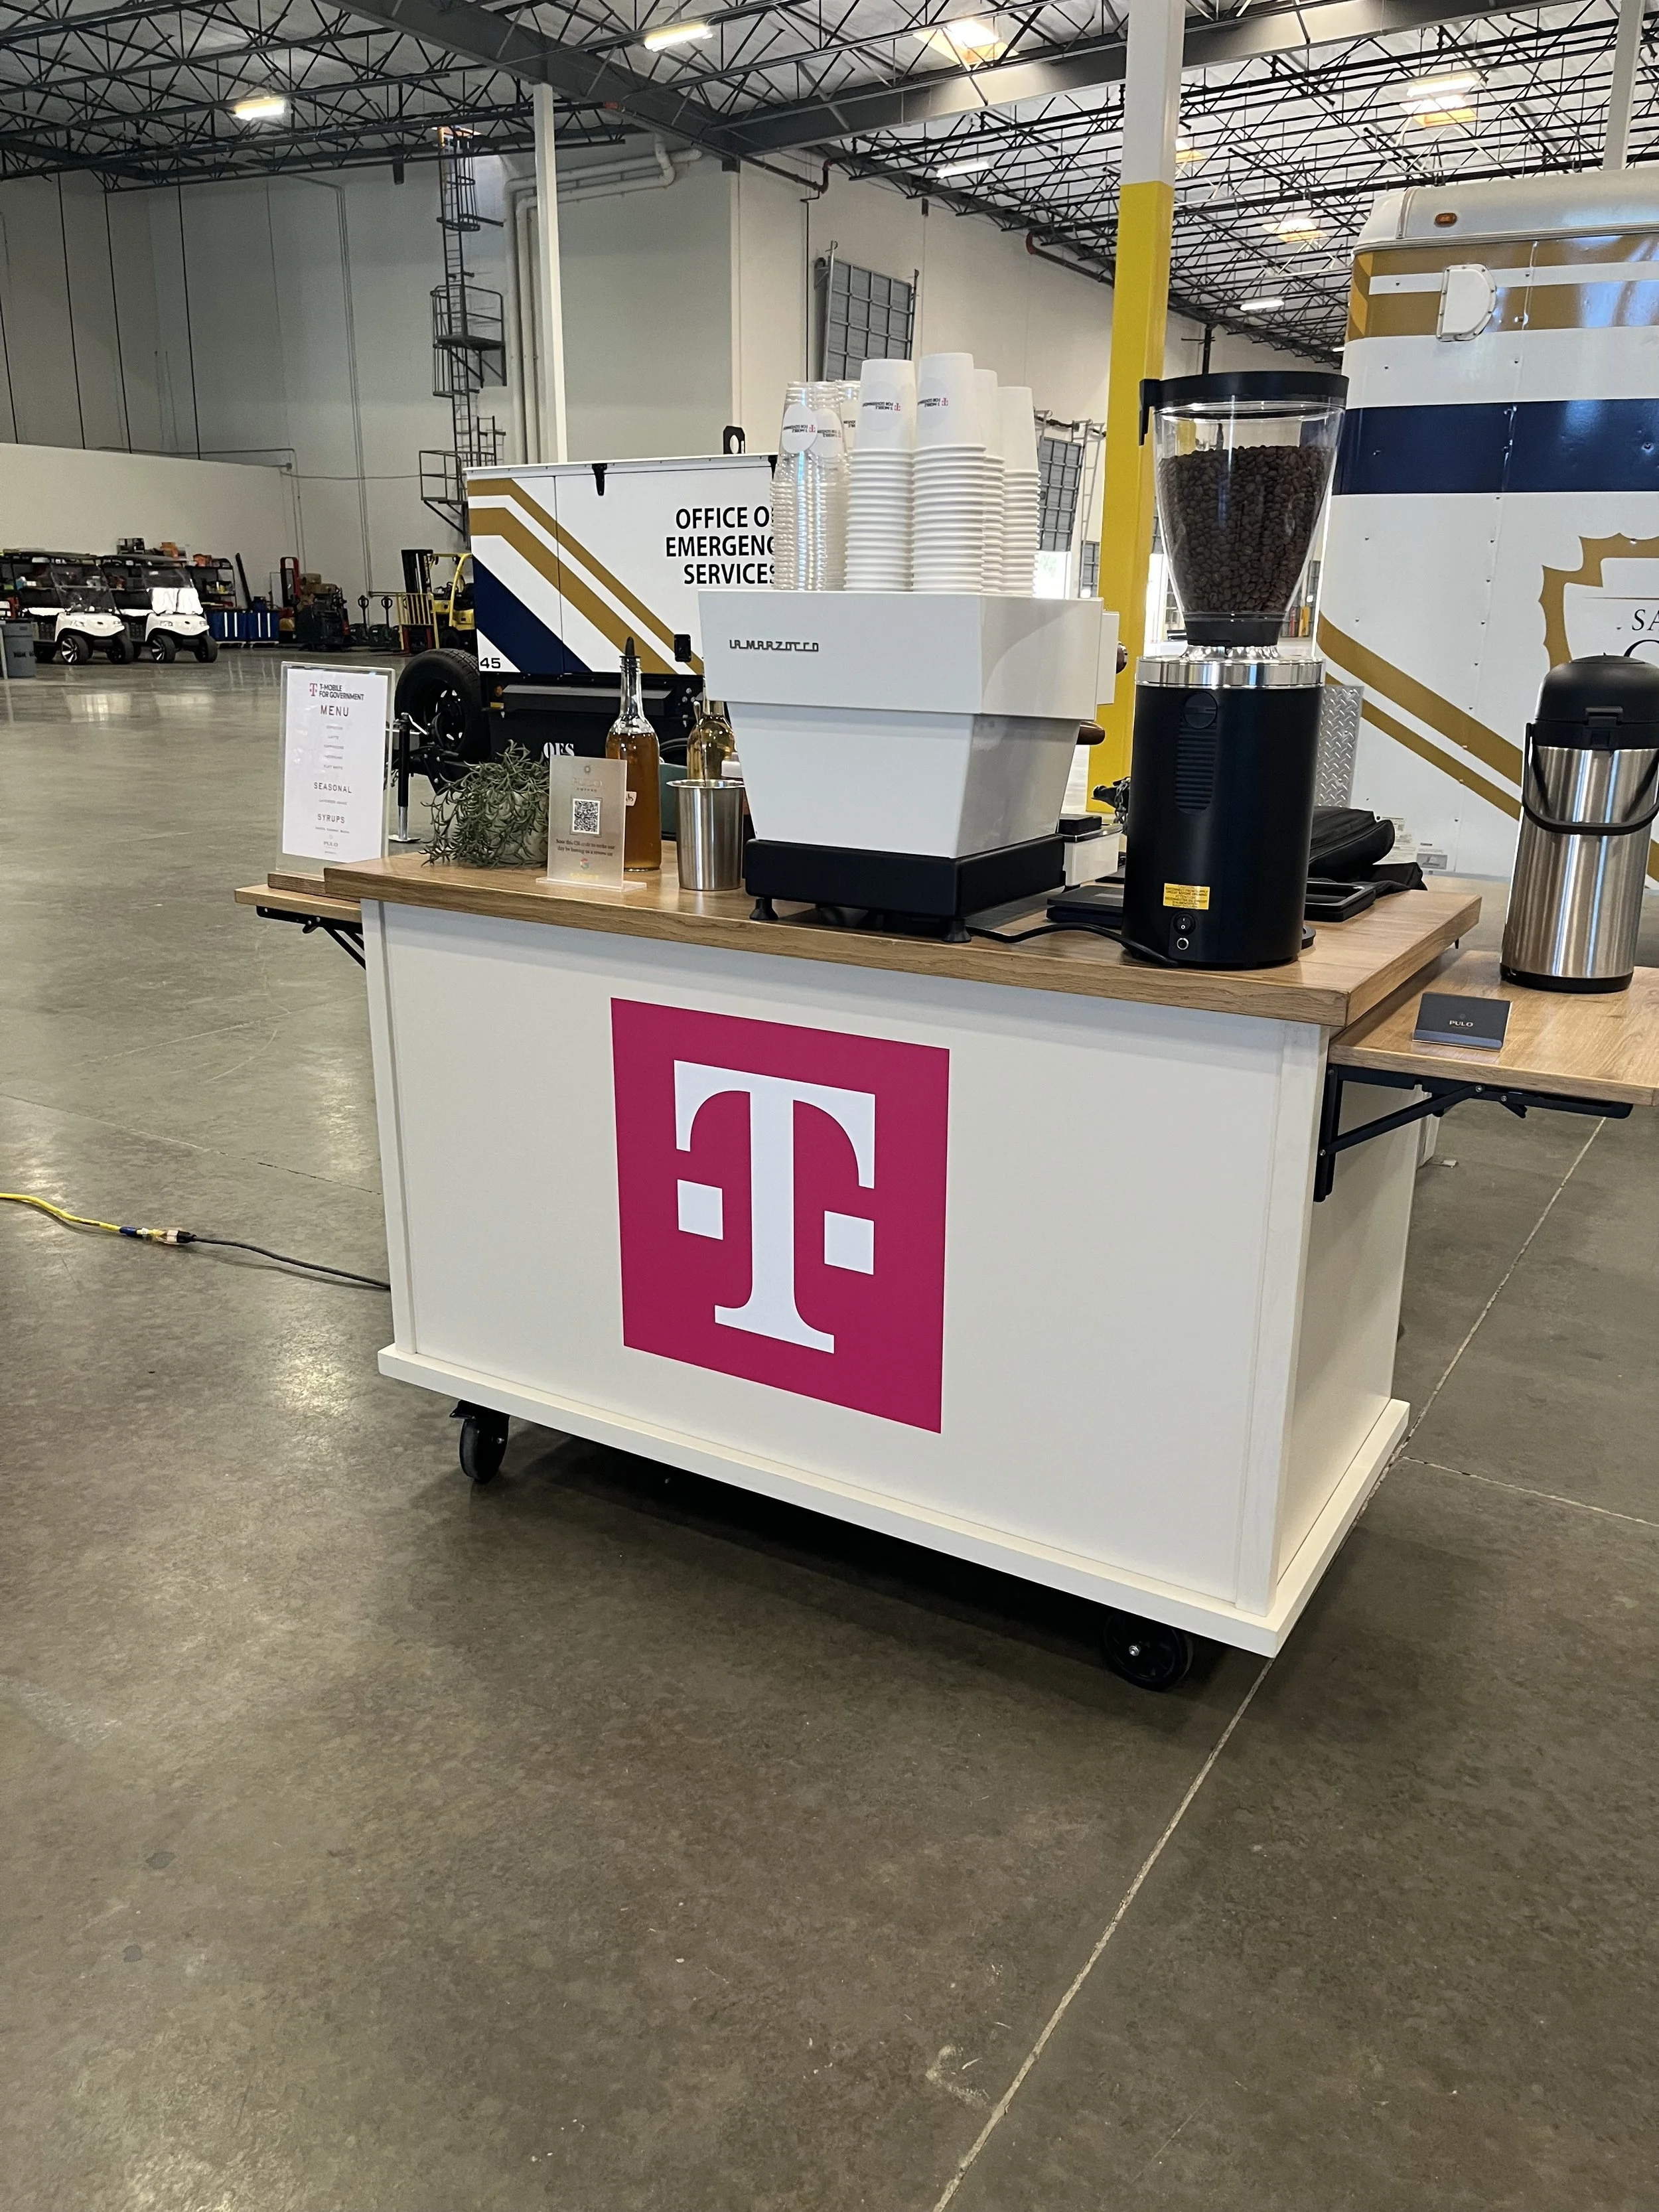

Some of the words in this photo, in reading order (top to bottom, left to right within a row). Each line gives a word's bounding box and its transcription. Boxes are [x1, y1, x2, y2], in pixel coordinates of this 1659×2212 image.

[676, 507, 748, 529] OFFICE
[754, 506, 774, 527] O
[666, 535, 774, 557] EMERGENC
[480, 658, 500, 668] 45
[329, 692, 364, 701] GOVERNMENT
[320, 705, 349, 717] MENU
[314, 782, 352, 794] SEASONAL
[317, 813, 346, 824] SYRUPS
